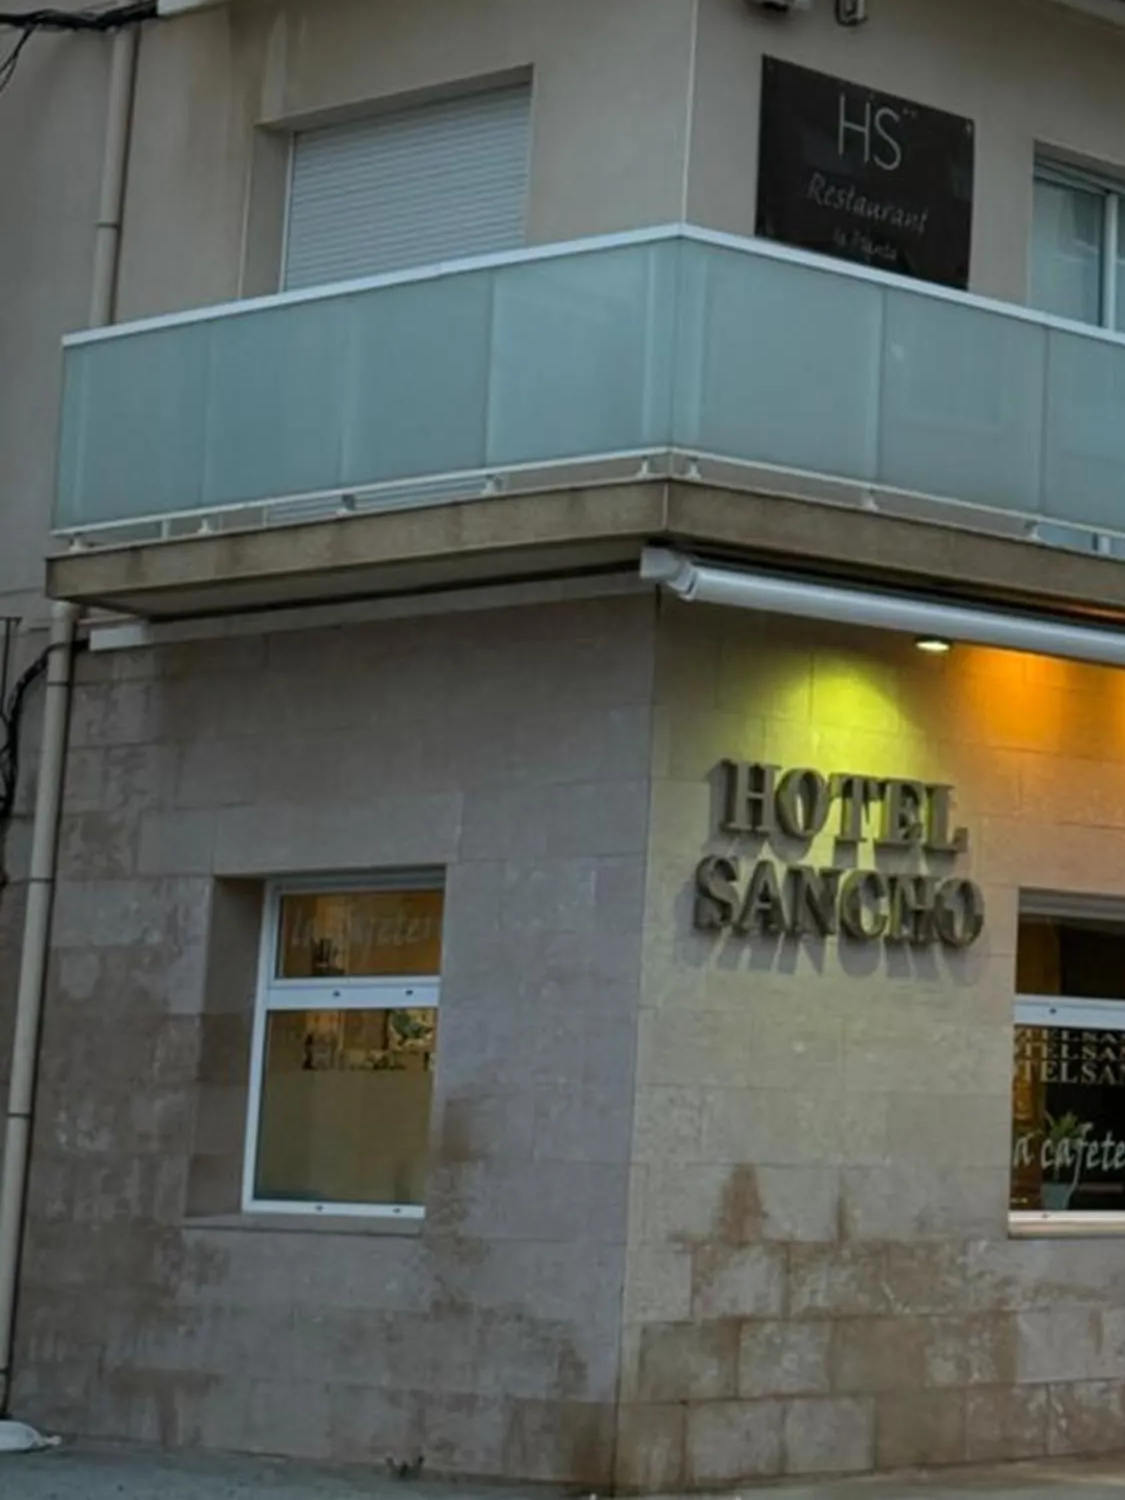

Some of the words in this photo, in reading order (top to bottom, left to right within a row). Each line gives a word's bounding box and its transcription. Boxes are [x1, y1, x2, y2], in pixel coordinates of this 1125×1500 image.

[838, 93, 902, 171] HS
[807, 172, 929, 235] Restaurant
[706, 757, 969, 852] HOTEL
[694, 854, 985, 949] SANCHO
